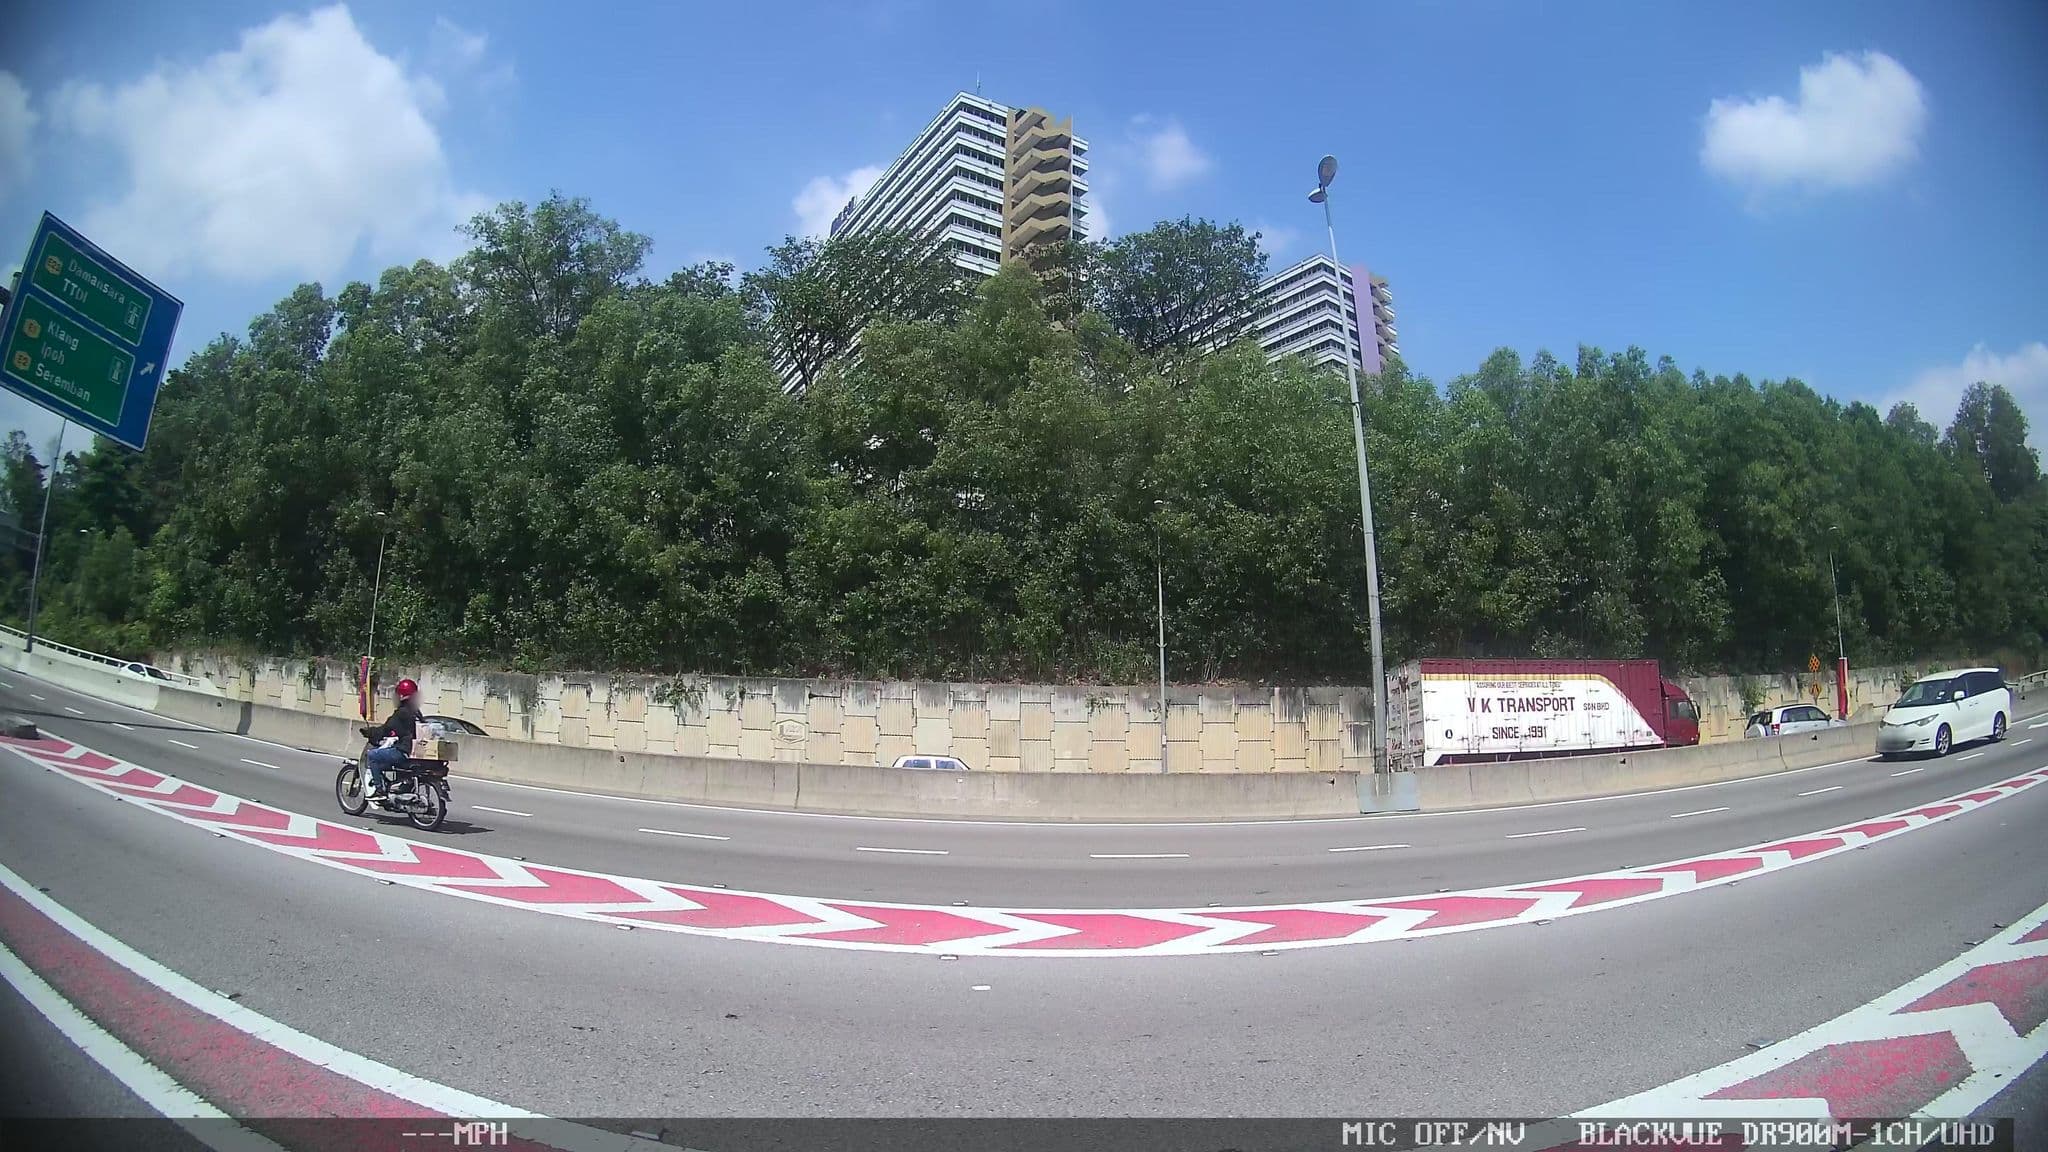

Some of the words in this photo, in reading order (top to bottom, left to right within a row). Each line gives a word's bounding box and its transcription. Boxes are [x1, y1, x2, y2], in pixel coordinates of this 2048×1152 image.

[63, 279, 88, 303] TTDI
[69, 259, 125, 304] Damansara
[48, 320, 79, 351] Klang
[41, 342, 65, 365] Ipoh
[35, 363, 91, 402] Seremban
[1467, 697, 1475, 712] V
[1481, 698, 1491, 713] K
[1497, 697, 1575, 712] TRANSPORT
[1492, 726, 1519, 739] SINCE
